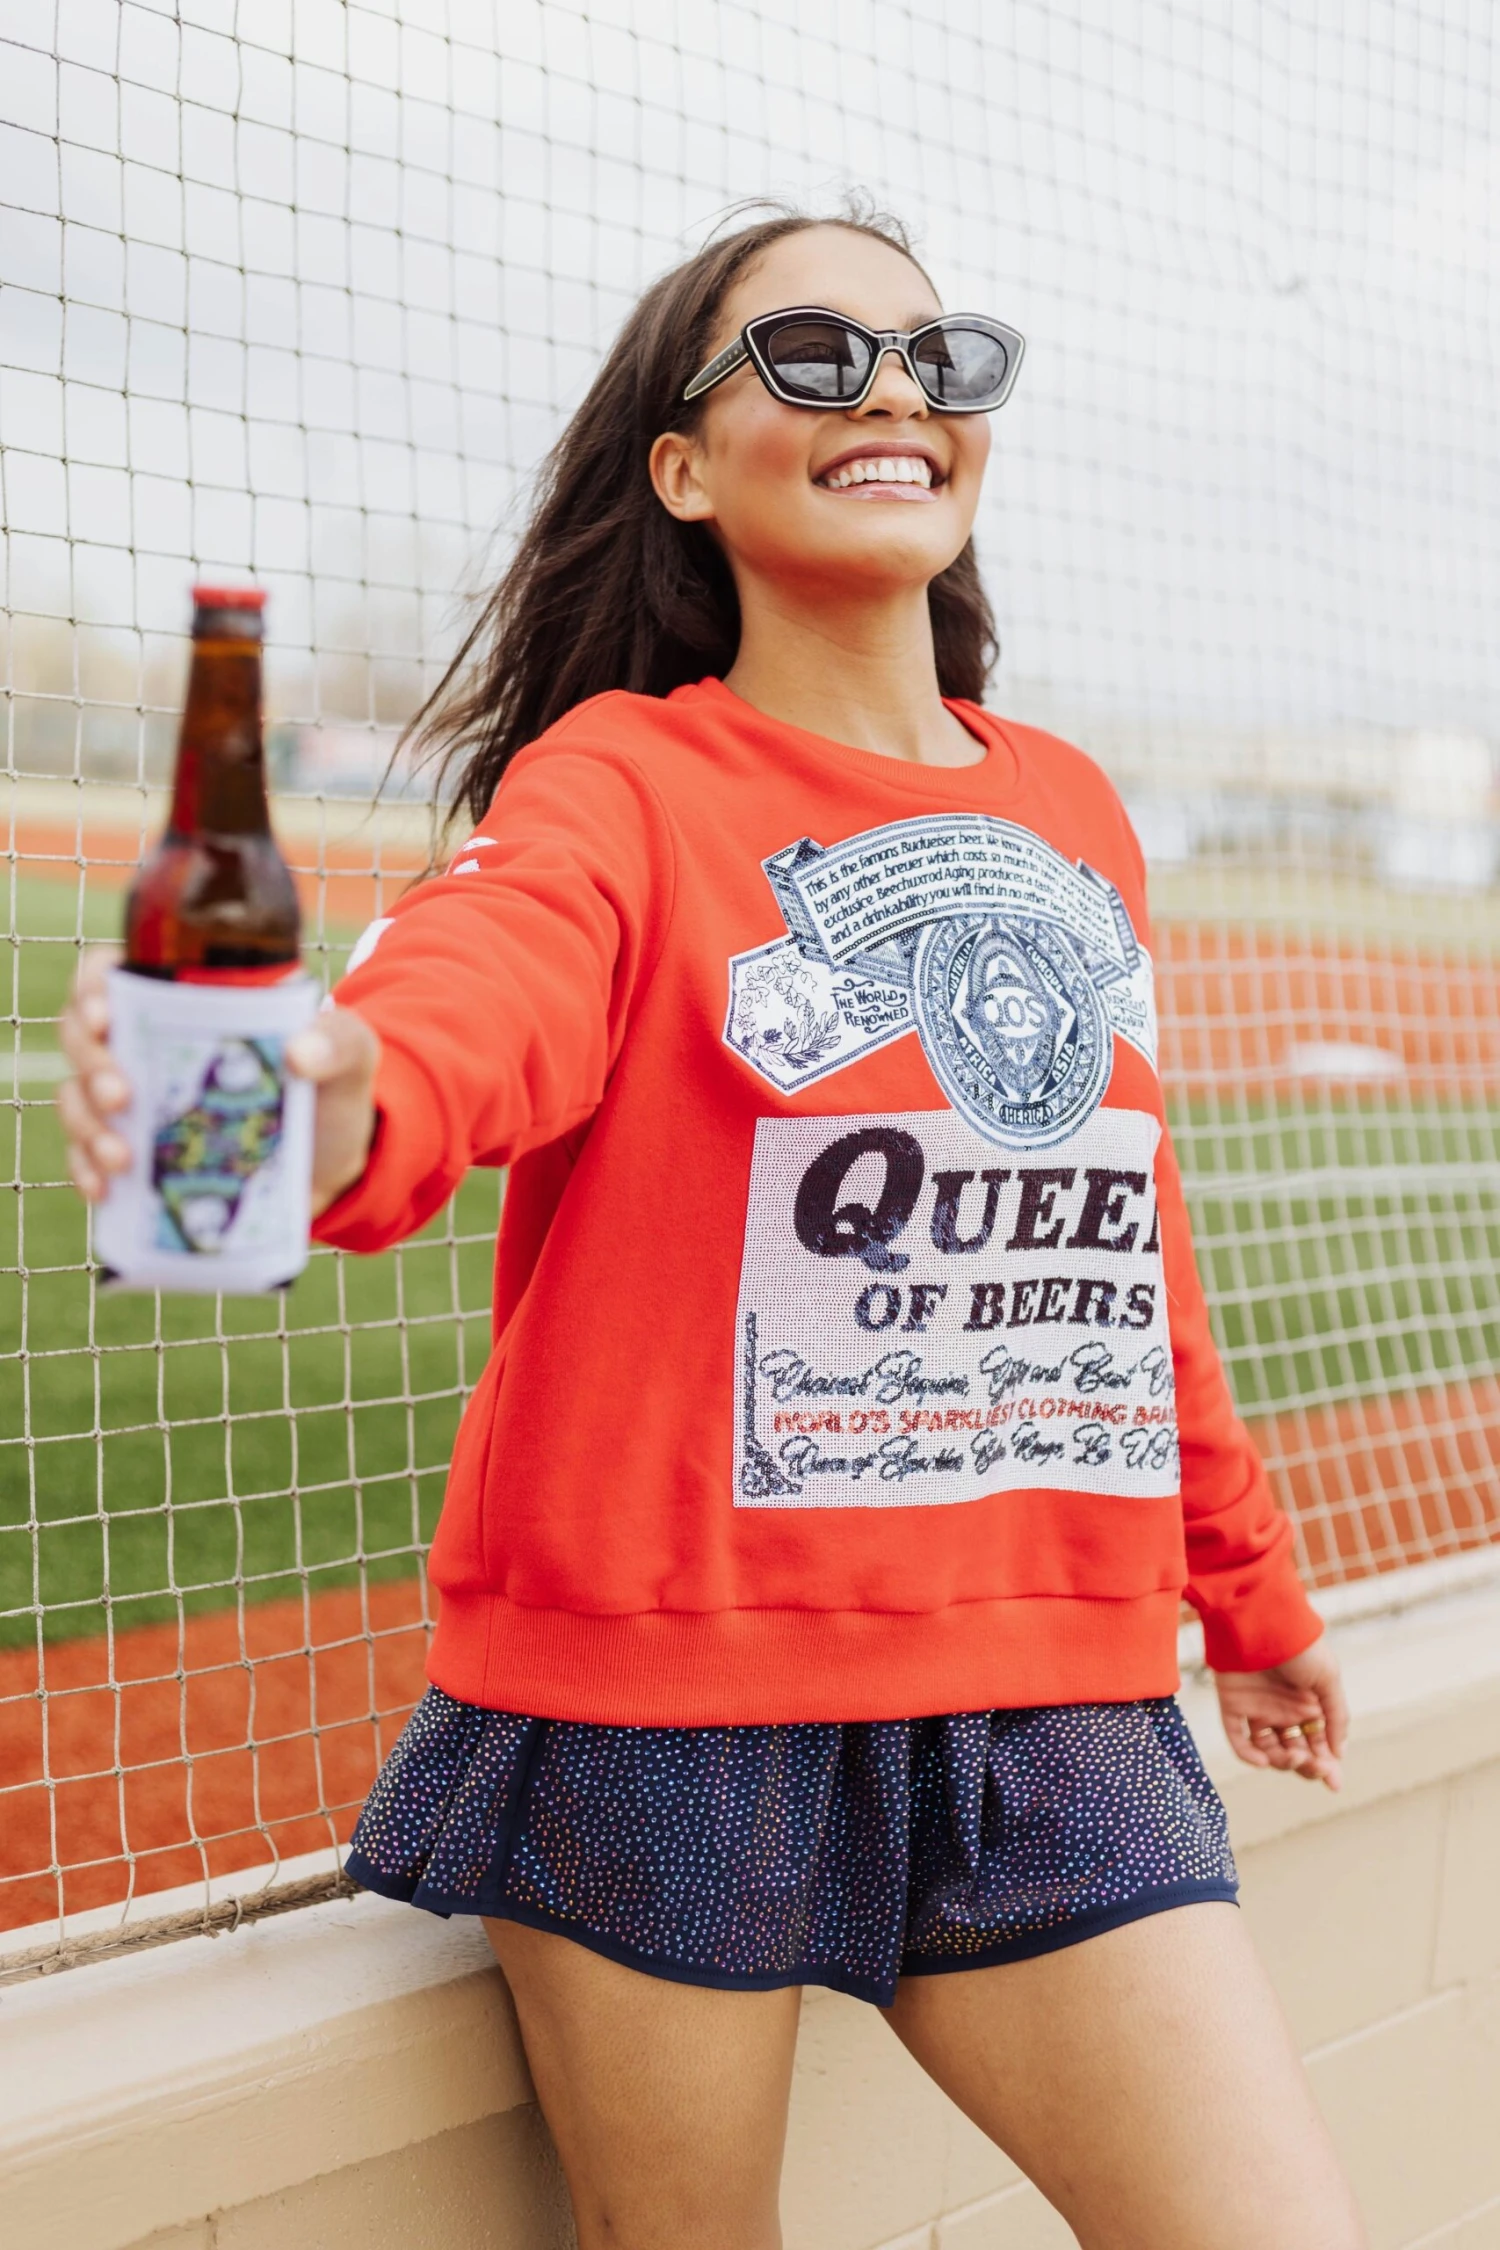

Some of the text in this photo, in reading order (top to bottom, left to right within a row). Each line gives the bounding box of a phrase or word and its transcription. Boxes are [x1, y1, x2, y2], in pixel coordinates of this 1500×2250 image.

[805, 877, 828, 897] This
[829, 870, 840, 884] is
[840, 862, 860, 878] the
[813, 899, 829, 914] by
[830, 884, 850, 904] any
[853, 870, 881, 892] other
[926, 849, 960, 866] which
[962, 850, 988, 862] costs
[991, 851, 1001, 862] so
[1003, 853, 1028, 870] much
[1028, 861, 1038, 873] to
[944, 865, 975, 881] Aging
[978, 866, 1025, 884] produces
[1026, 876, 1033, 886] a
[830, 923, 852, 945] and
[853, 921, 861, 932] a
[927, 887, 950, 905] you
[952, 883, 972, 896] will
[974, 882, 995, 896] find
[997, 883, 1007, 896] in
[1009, 888, 1021, 900] no
[1023, 890, 1046, 907] other
[959, 1036, 997, 1086] AFRICA
[1051, 1042, 1076, 1085] ASIA
[794, 1127, 1160, 1273] QUEE
[854, 1276, 1156, 1333] OF BEERS
[1018, 1397, 1128, 1425] CLOTHING
